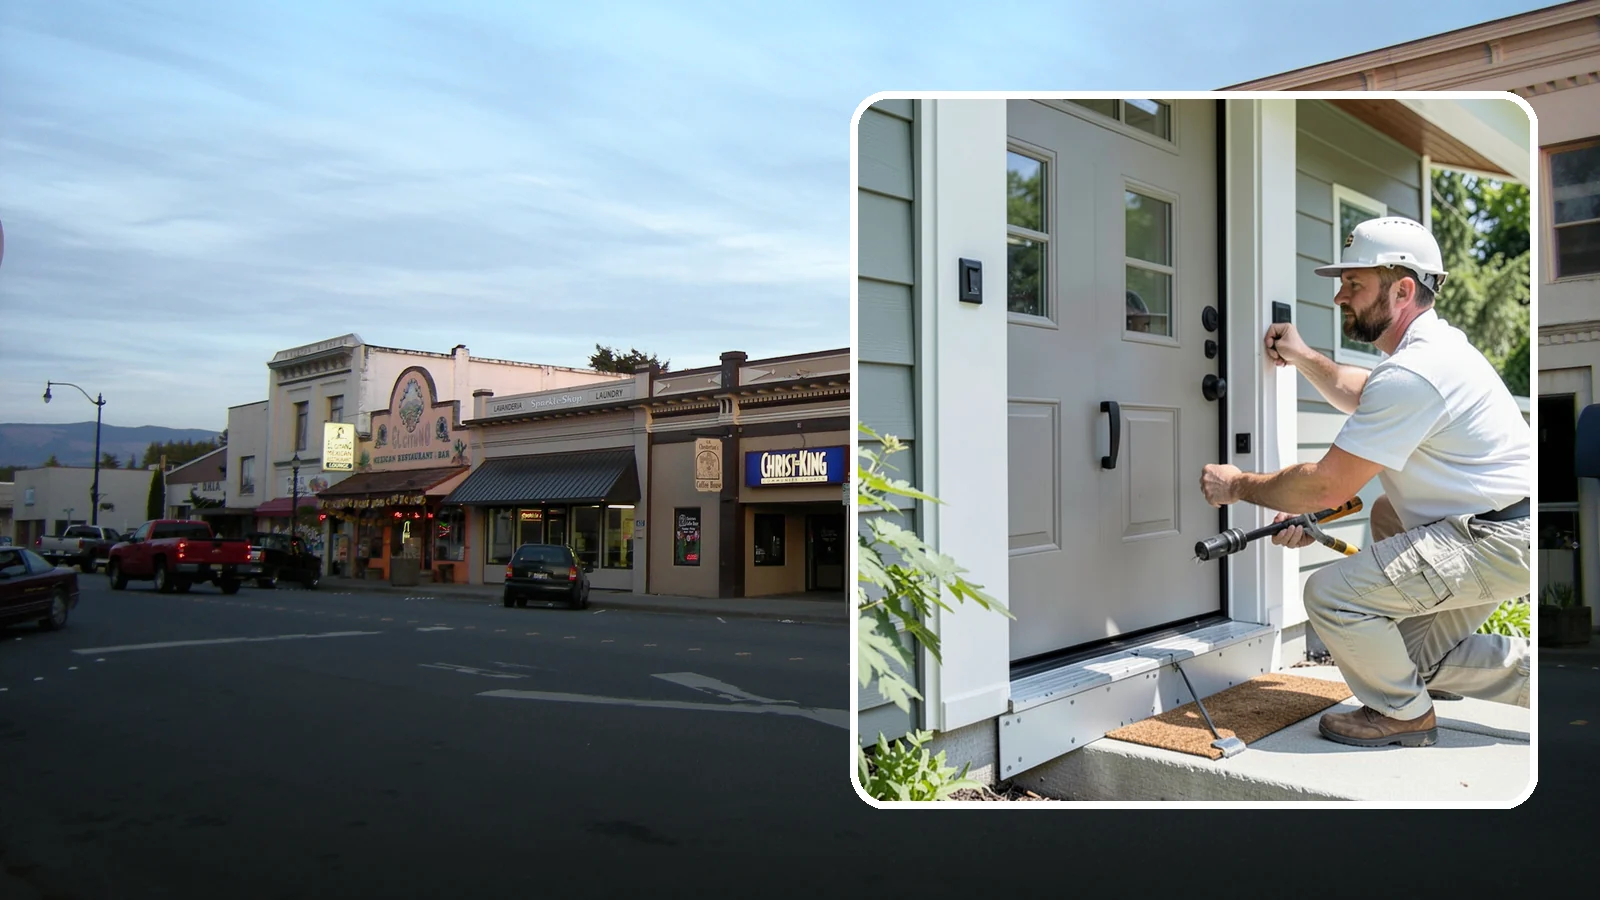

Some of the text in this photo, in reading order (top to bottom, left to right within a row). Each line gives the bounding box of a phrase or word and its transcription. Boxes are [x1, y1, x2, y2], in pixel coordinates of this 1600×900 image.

[493, 402, 523, 413] LAVANDERIA
[595, 389, 623, 400] LAUNDRY
[374, 450, 450, 464] MEXICAN RESTAURANT BAR
[761, 450, 827, 478] CHRIST KING
